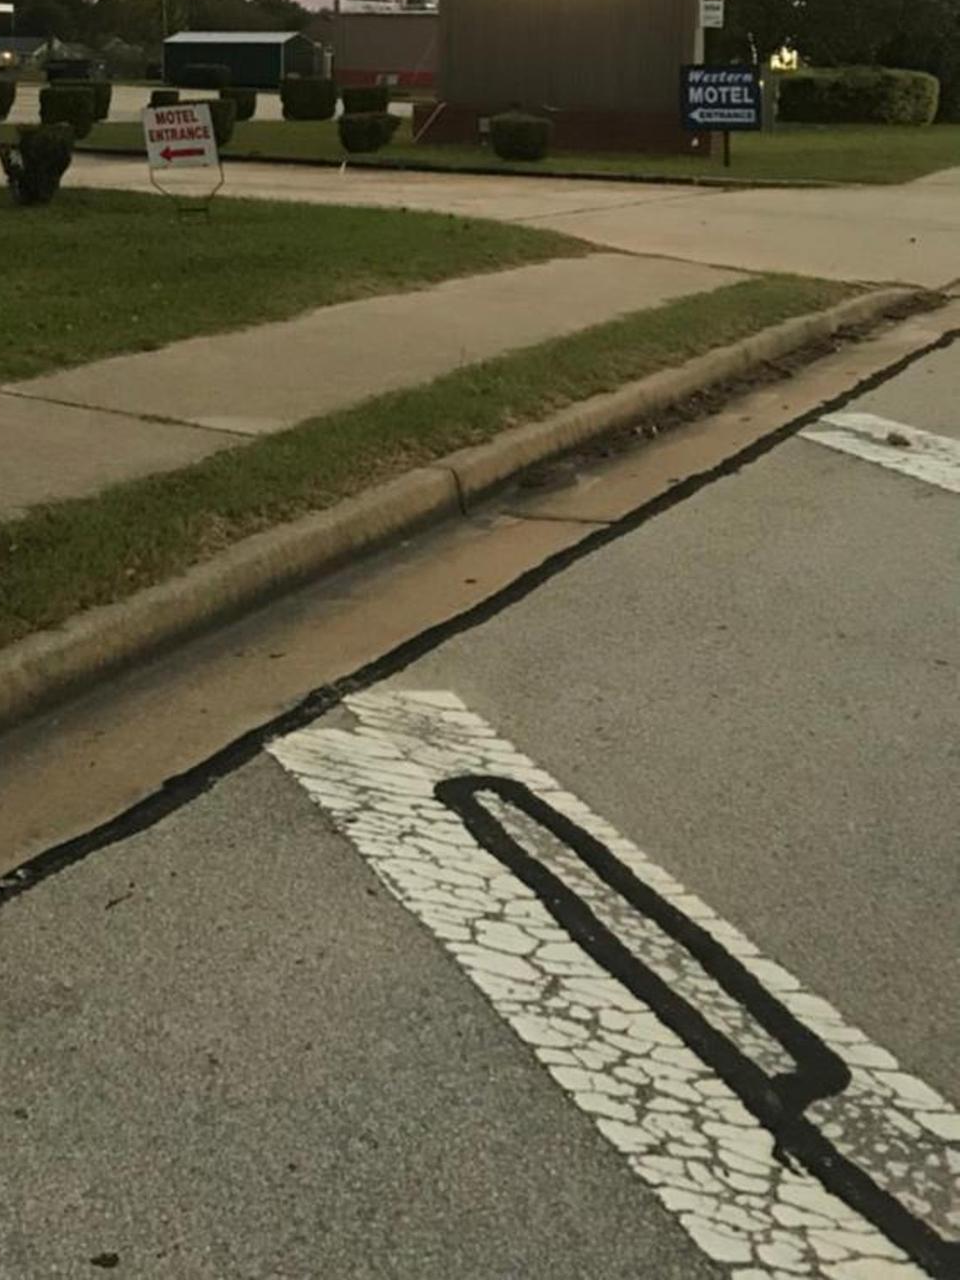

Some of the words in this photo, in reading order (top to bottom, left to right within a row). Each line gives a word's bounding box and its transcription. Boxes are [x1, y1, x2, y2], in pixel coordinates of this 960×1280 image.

[688, 70, 753, 83] Western
[689, 86, 754, 104] MOTEL
[155, 109, 199, 125] MOTEL
[148, 126, 211, 142] ENTRANCE
